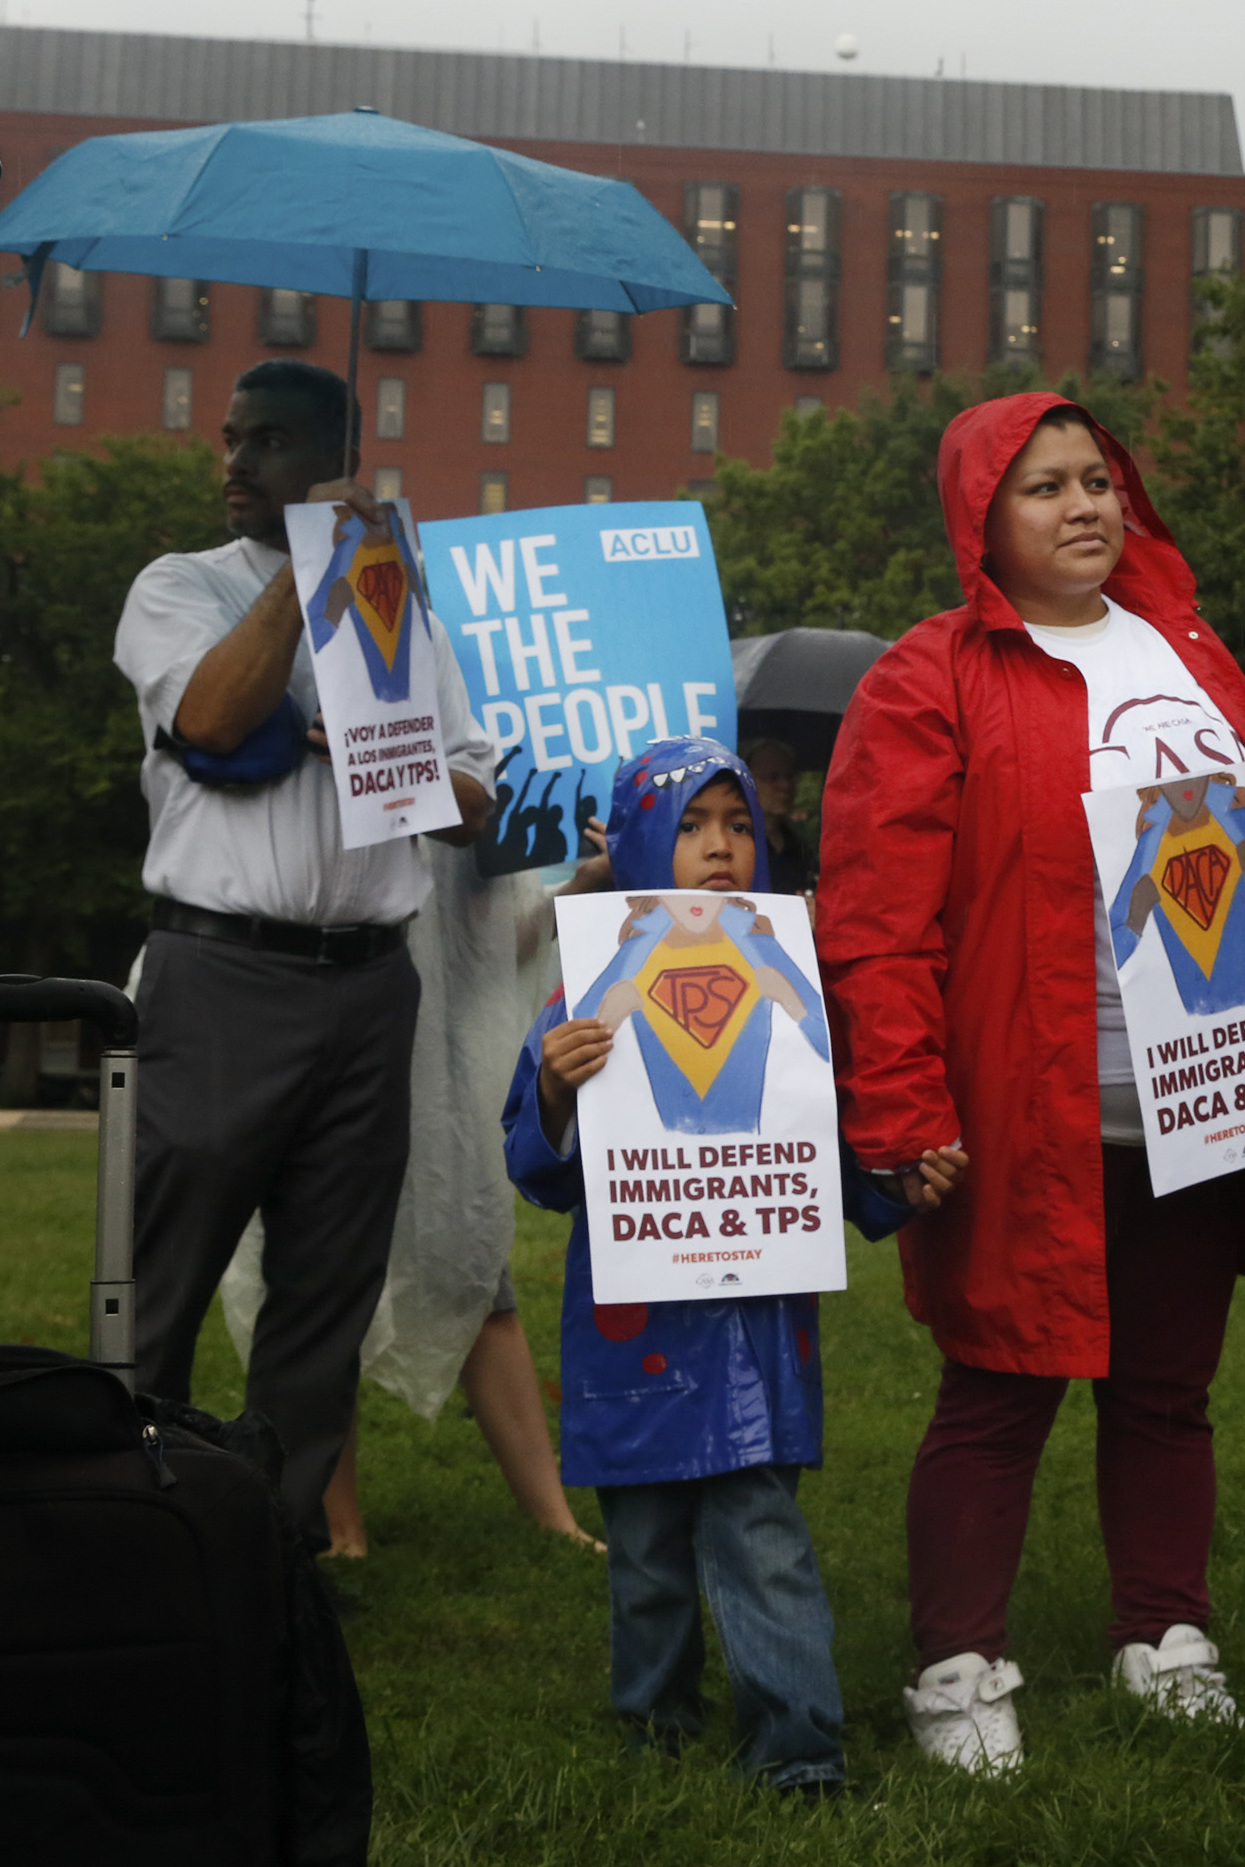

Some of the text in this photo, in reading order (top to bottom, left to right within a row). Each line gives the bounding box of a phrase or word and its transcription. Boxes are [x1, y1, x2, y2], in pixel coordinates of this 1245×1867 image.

[610, 530, 692, 558] ACLU
[450, 533, 568, 617] WE
[461, 609, 601, 697] THE
[344, 715, 434, 747] ¡VOY A DEFENDER
[348, 753, 356, 767] A
[358, 750, 377, 765] LOS
[350, 758, 440, 797] DACA Y TPS!
[665, 970, 738, 1031] TPS
[1146, 1047, 1154, 1068] I
[1157, 1033, 1209, 1065] WILL
[1157, 1091, 1229, 1135] DACA
[607, 1141, 816, 1171] I WILL DEFEND
[609, 1172, 818, 1203] IMMIGRANTS,
[612, 1205, 821, 1241] DACA & TPS
[672, 1249, 762, 1264] #HERETOSTAY
